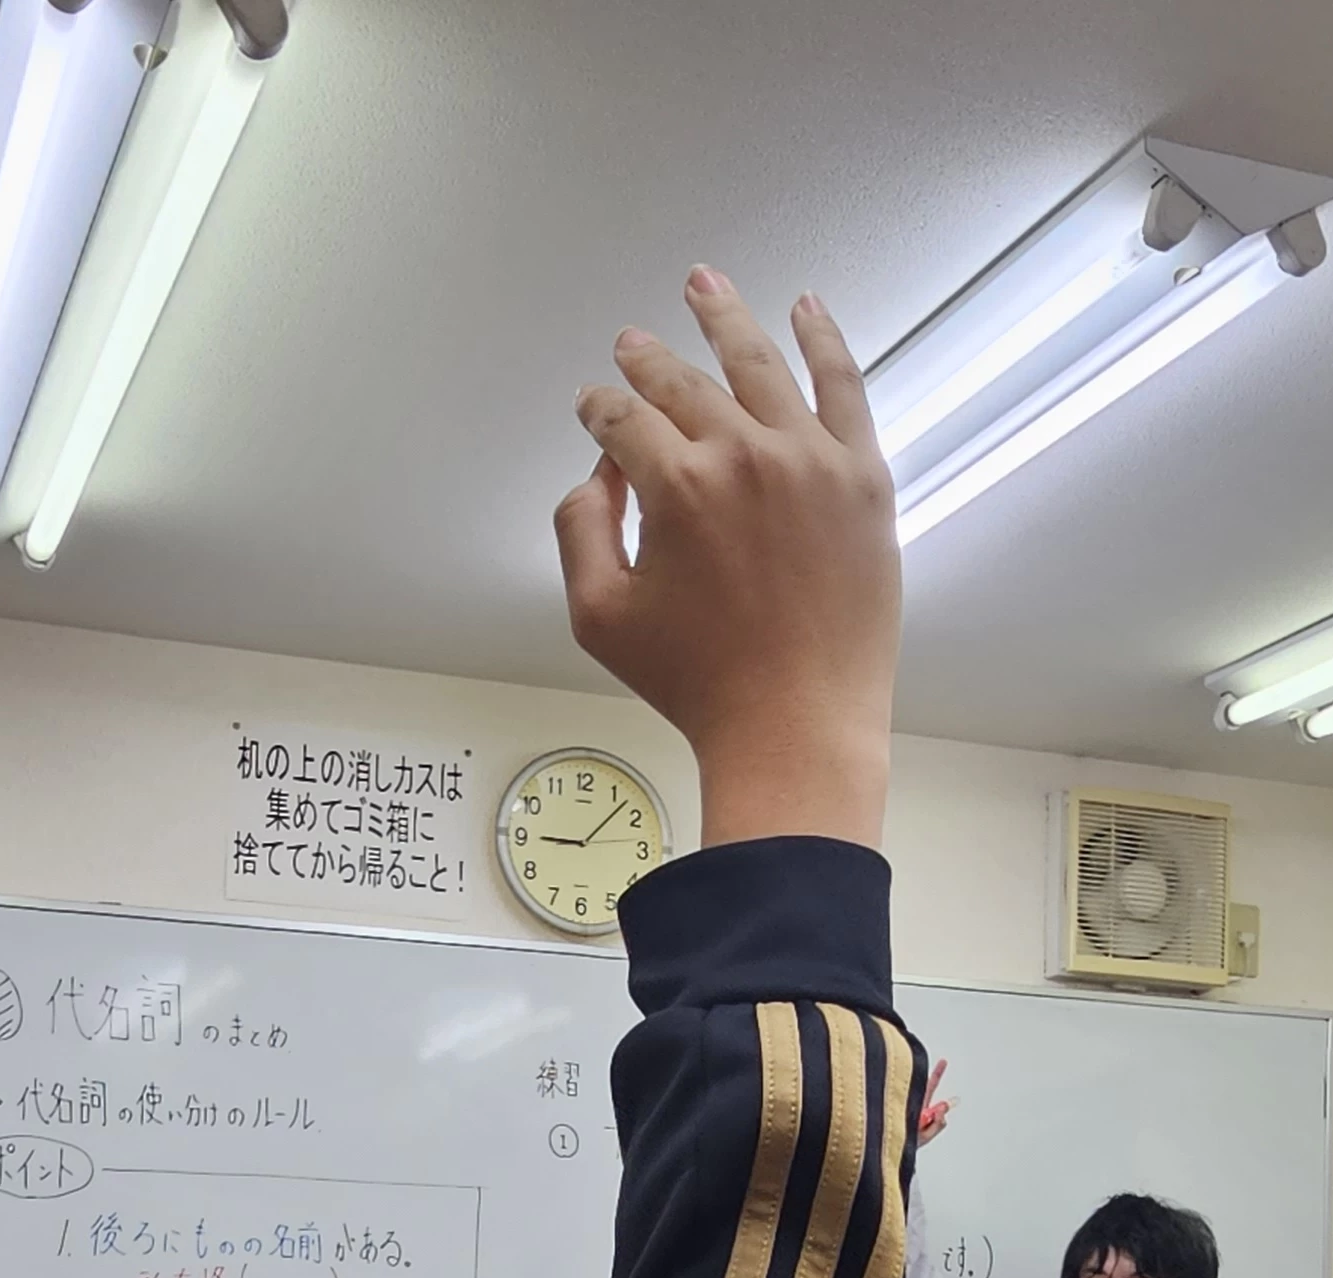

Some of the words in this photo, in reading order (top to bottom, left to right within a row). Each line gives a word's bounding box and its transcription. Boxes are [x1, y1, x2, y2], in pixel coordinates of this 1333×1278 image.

[237, 736, 463, 801] 机の上の消しカスは
[548, 777, 562, 796] 11
[576, 772, 594, 792] 12
[611, 785, 617, 802] 1
[266, 787, 434, 843] 集めてゴミ箱に
[523, 796, 541, 815] 10
[629, 809, 642, 828] 2
[515, 827, 528, 846] 9
[636, 841, 649, 860] 3
[233, 831, 465, 893] 捨ててから帰ること!
[524, 860, 537, 880] 8
[547, 887, 560, 906] 7
[605, 893, 617, 911] 5
[575, 897, 587, 916] 6
[536, 1057, 580, 1099] 練習
